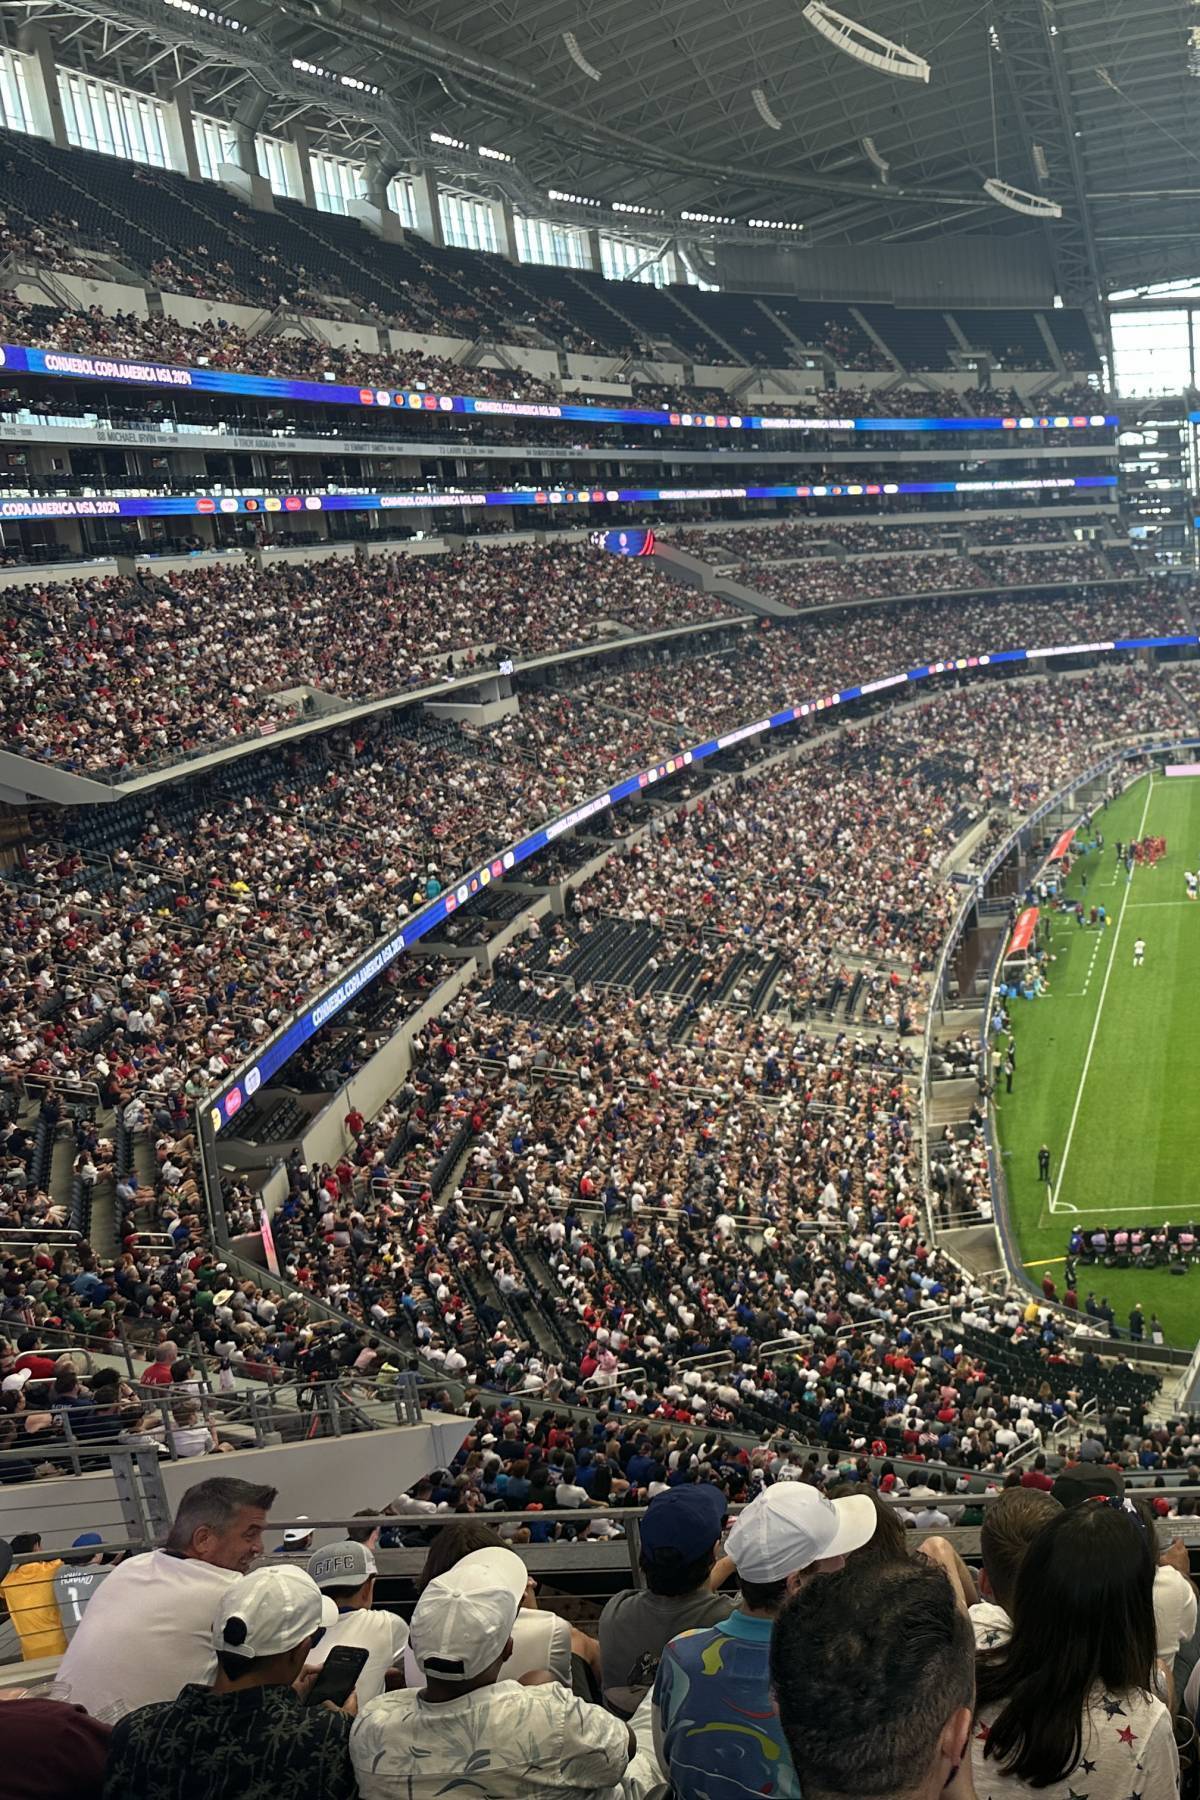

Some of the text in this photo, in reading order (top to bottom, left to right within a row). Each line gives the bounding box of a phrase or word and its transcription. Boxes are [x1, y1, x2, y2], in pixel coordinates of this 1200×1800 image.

[45, 354, 192, 385] CONMEBOL COPA AMERICA USA 2024
[107, 433, 135, 442] MICHAEL
[2, 501, 120, 516] COPA AMERICA USA 2024
[315, 1554, 354, 1576] GTFC
[68, 1587, 82, 1621] 1
